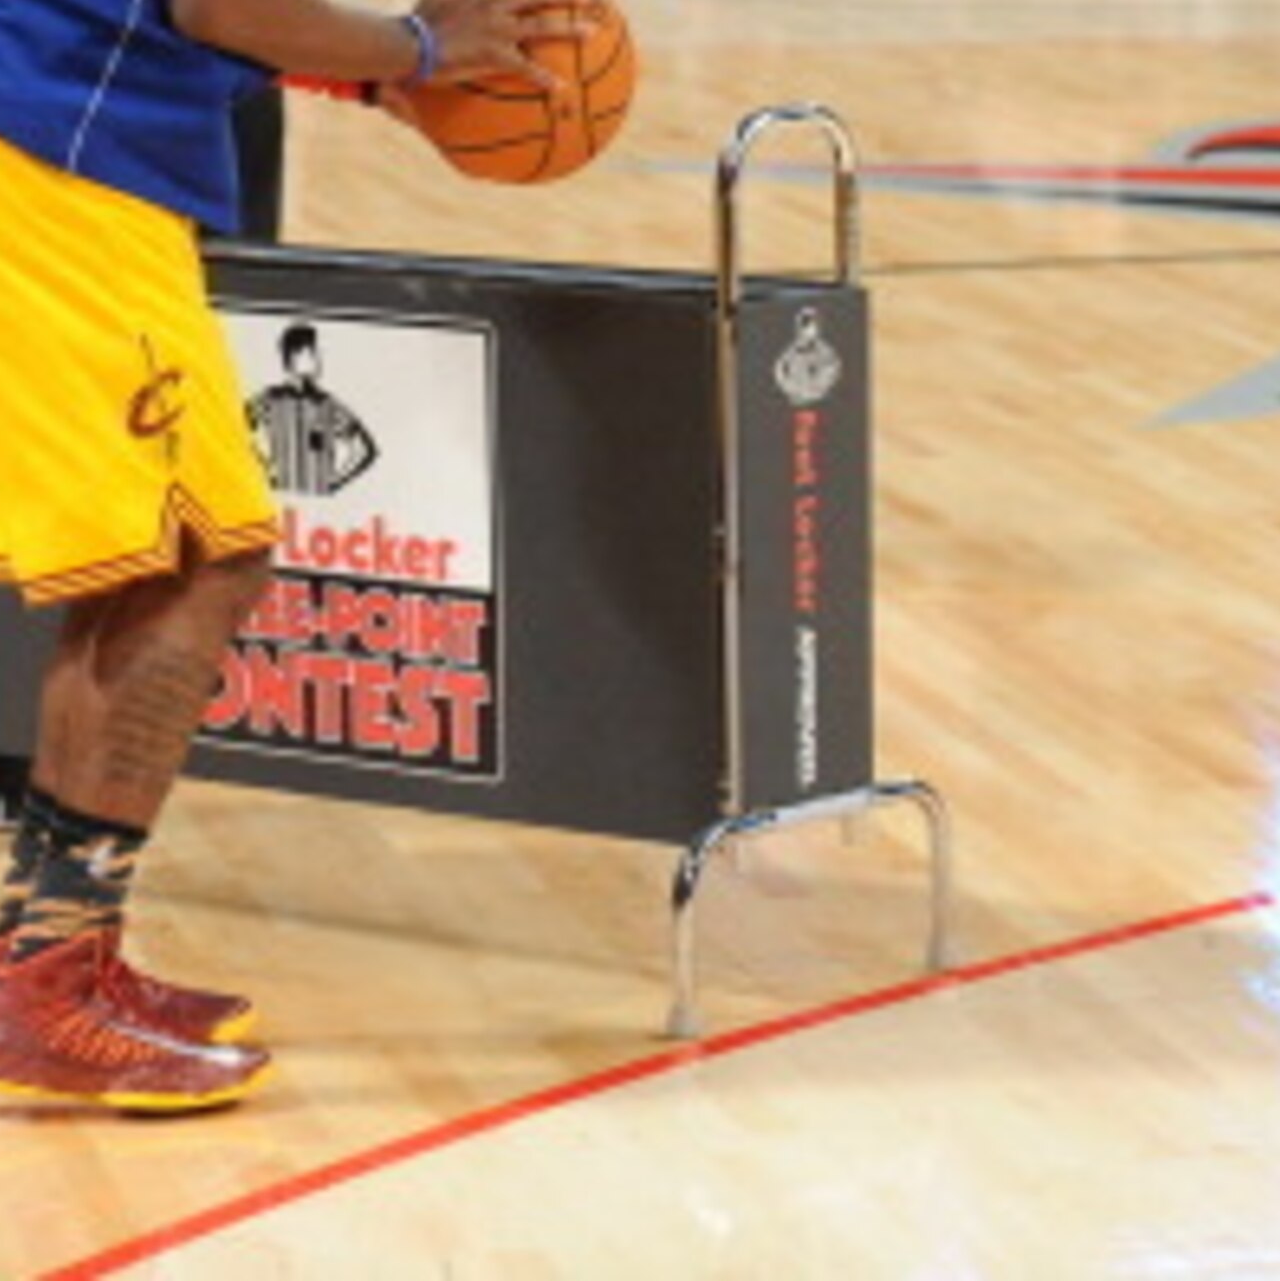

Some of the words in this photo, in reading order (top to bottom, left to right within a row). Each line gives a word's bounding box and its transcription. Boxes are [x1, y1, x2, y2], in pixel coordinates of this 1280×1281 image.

[283, 507, 457, 580] Locker
[791, 494, 822, 613] Locker
[197, 644, 491, 763] ONTEST
